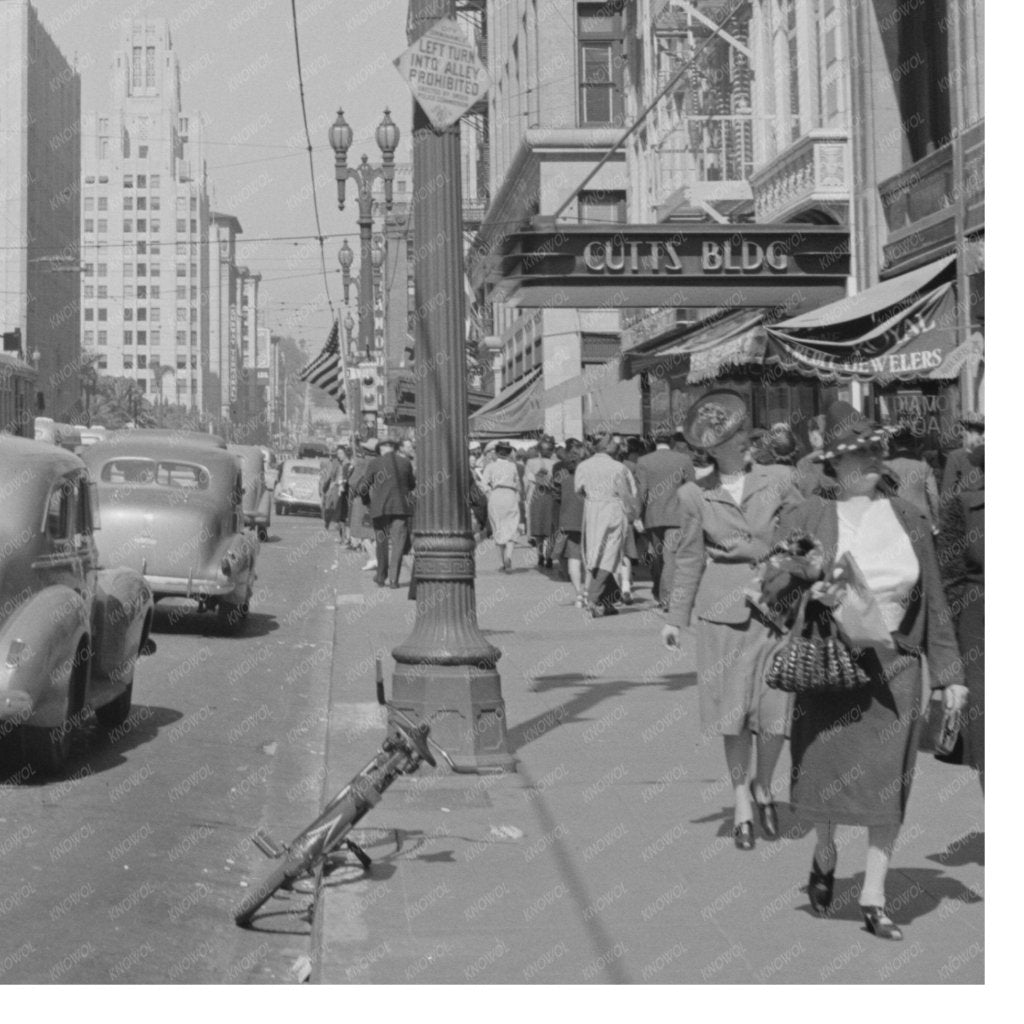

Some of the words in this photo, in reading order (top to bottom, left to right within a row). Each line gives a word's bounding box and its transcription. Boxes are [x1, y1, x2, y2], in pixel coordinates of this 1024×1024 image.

[419, 39, 445, 56] LEFT
[446, 45, 475, 64] TURN
[410, 53, 438, 71] INTO
[444, 61, 479, 80] ALLEY
[409, 69, 479, 97] PROHIBITED
[583, 240, 683, 273] CUTTS
[702, 240, 789, 273] BLDG
